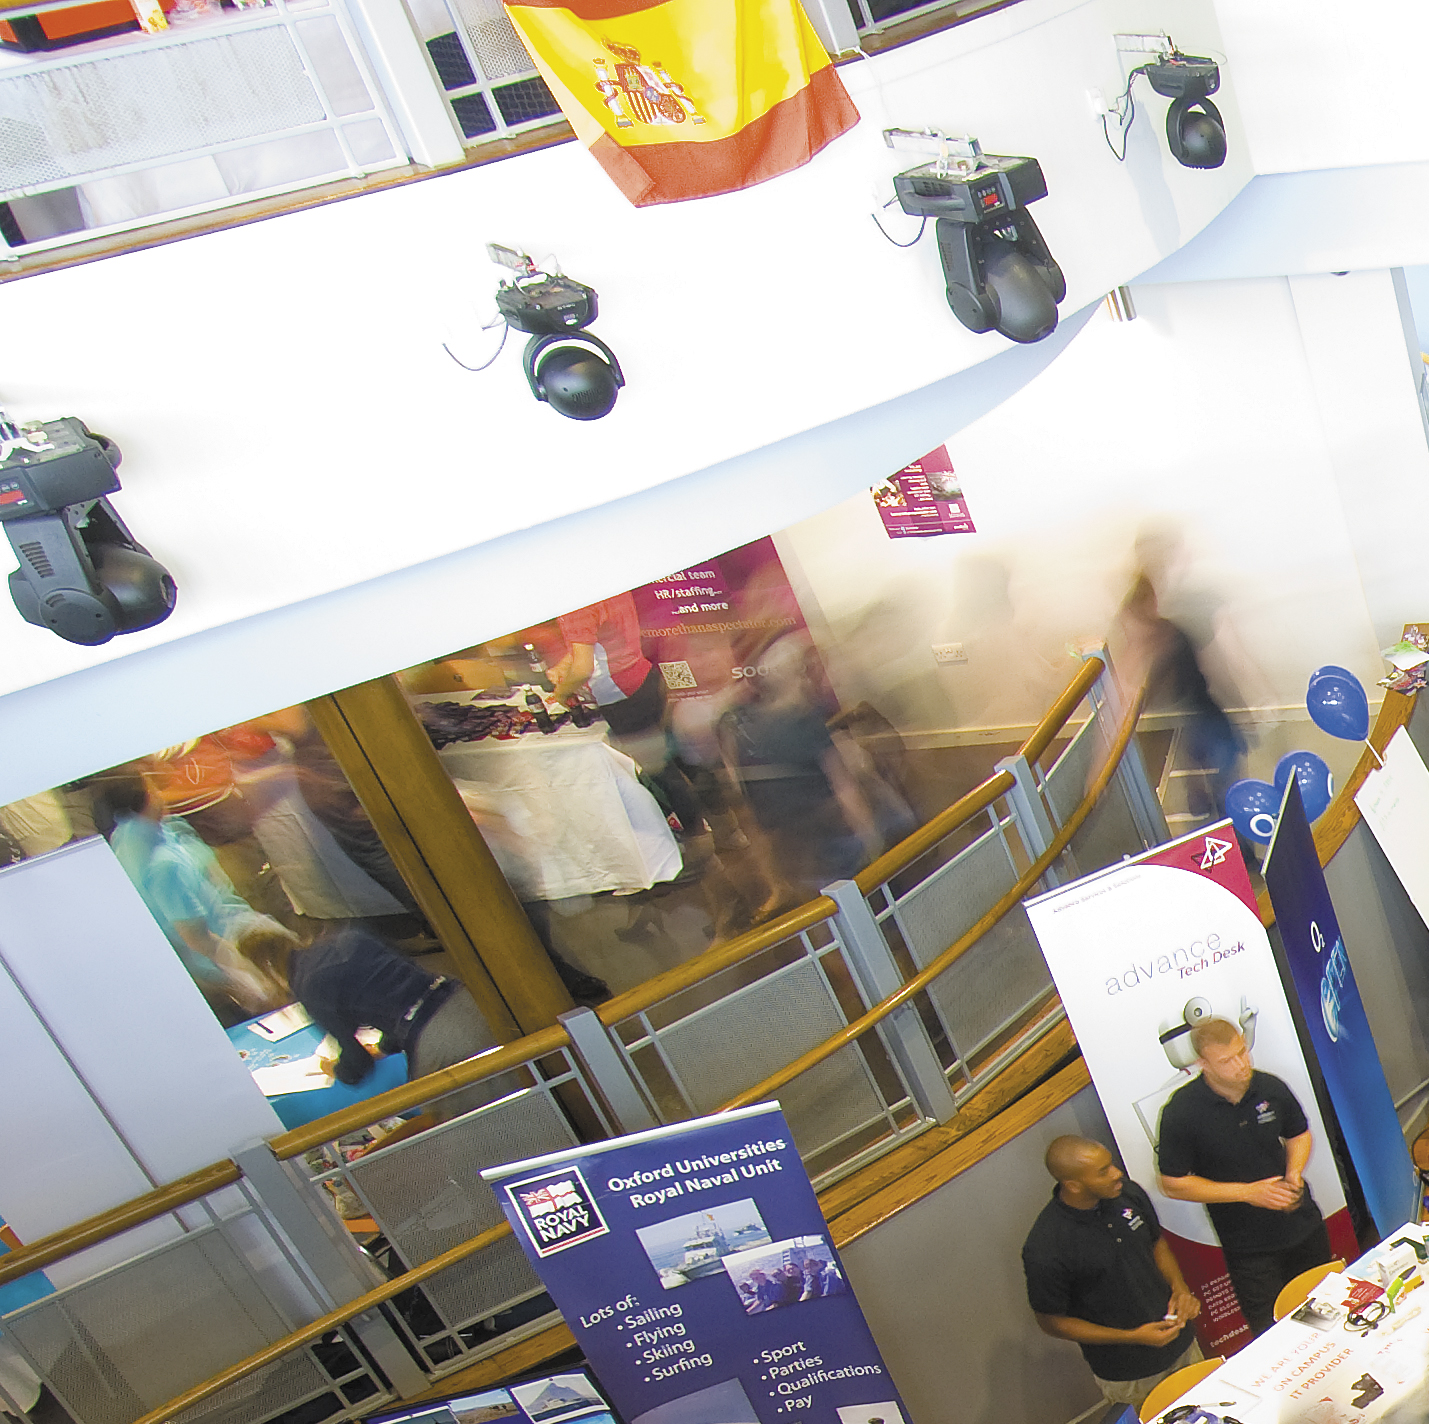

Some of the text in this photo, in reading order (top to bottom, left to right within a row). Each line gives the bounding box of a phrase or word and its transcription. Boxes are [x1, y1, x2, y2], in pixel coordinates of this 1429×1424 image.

[701, 600, 729, 612] more
[1105, 933, 1221, 996] advance
[1177, 941, 1246, 979] Tech Desk
[607, 1138, 787, 1192] Oxford Universities
[630, 1159, 783, 1209] Royal Naval Unit
[533, 1204, 588, 1231] ROYAL
[540, 1213, 590, 1243] NAVY
[579, 1294, 640, 1328] Lots of:
[624, 1303, 683, 1330] Sailing
[633, 1322, 686, 1347] Flying
[643, 1339, 695, 1364] Skiing
[761, 1340, 807, 1364] Sport
[652, 1353, 713, 1381] Surfing
[769, 1355, 823, 1379] Parties
[777, 1363, 882, 1394] Qualifications
[1251, 1371, 1273, 1389] WE
[1273, 1341, 1337, 1392] ON CAMPUS
[1289, 1348, 1354, 1400] IT PROVIDER
[785, 1394, 813, 1414] Pay
